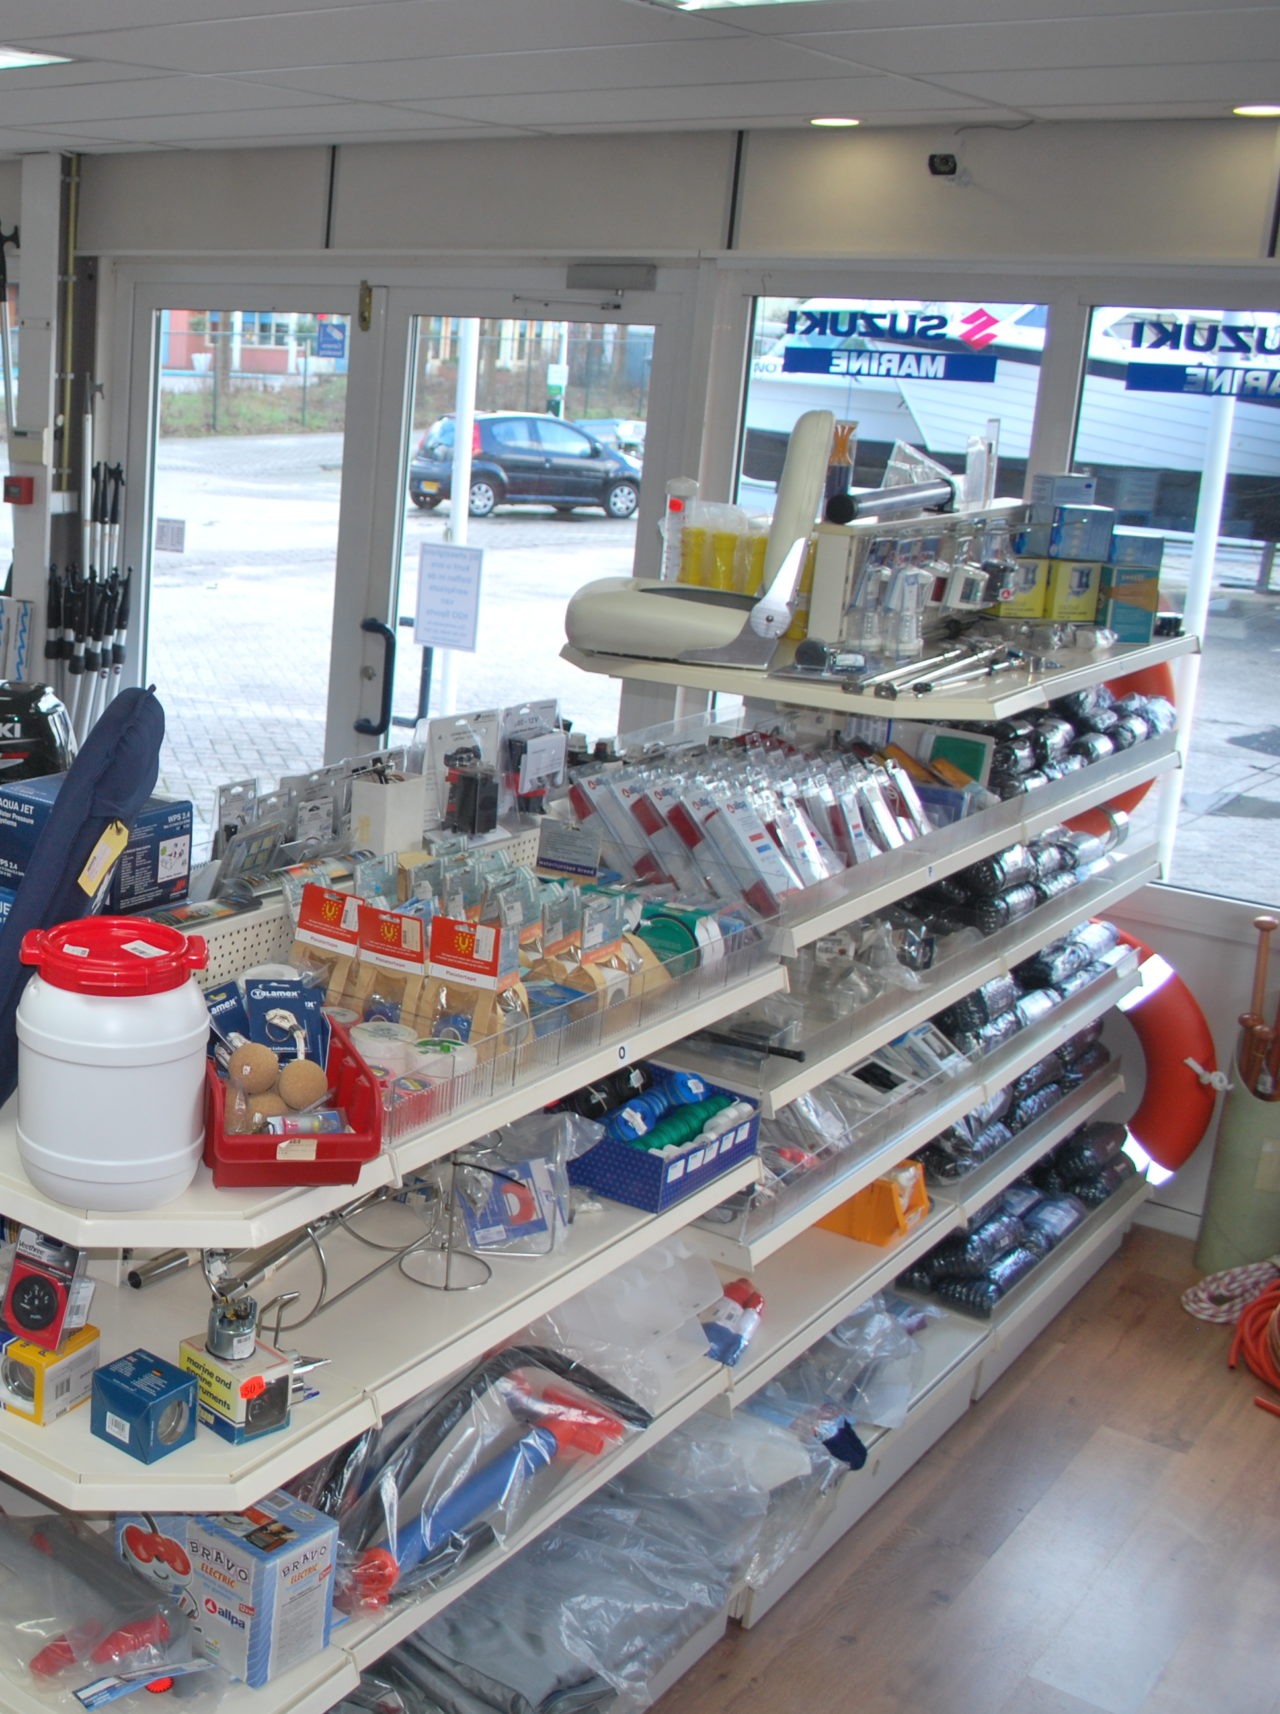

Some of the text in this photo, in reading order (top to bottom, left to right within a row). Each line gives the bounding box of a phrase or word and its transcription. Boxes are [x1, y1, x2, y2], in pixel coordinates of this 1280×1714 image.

[12, 813, 35, 825] Pressure
[20, 804, 35, 815] JET
[211, 998, 237, 1014] amex
[186, 1355, 214, 1378] marine
[215, 1374, 232, 1391] and
[199, 1384, 231, 1411] ruments
[189, 1541, 249, 1582] BRAVO
[281, 1545, 327, 1578] BRAVO
[290, 1563, 319, 1585] ELECTRIC
[201, 1563, 236, 1588] ELECTRIC
[217, 1604, 246, 1630] allpa
